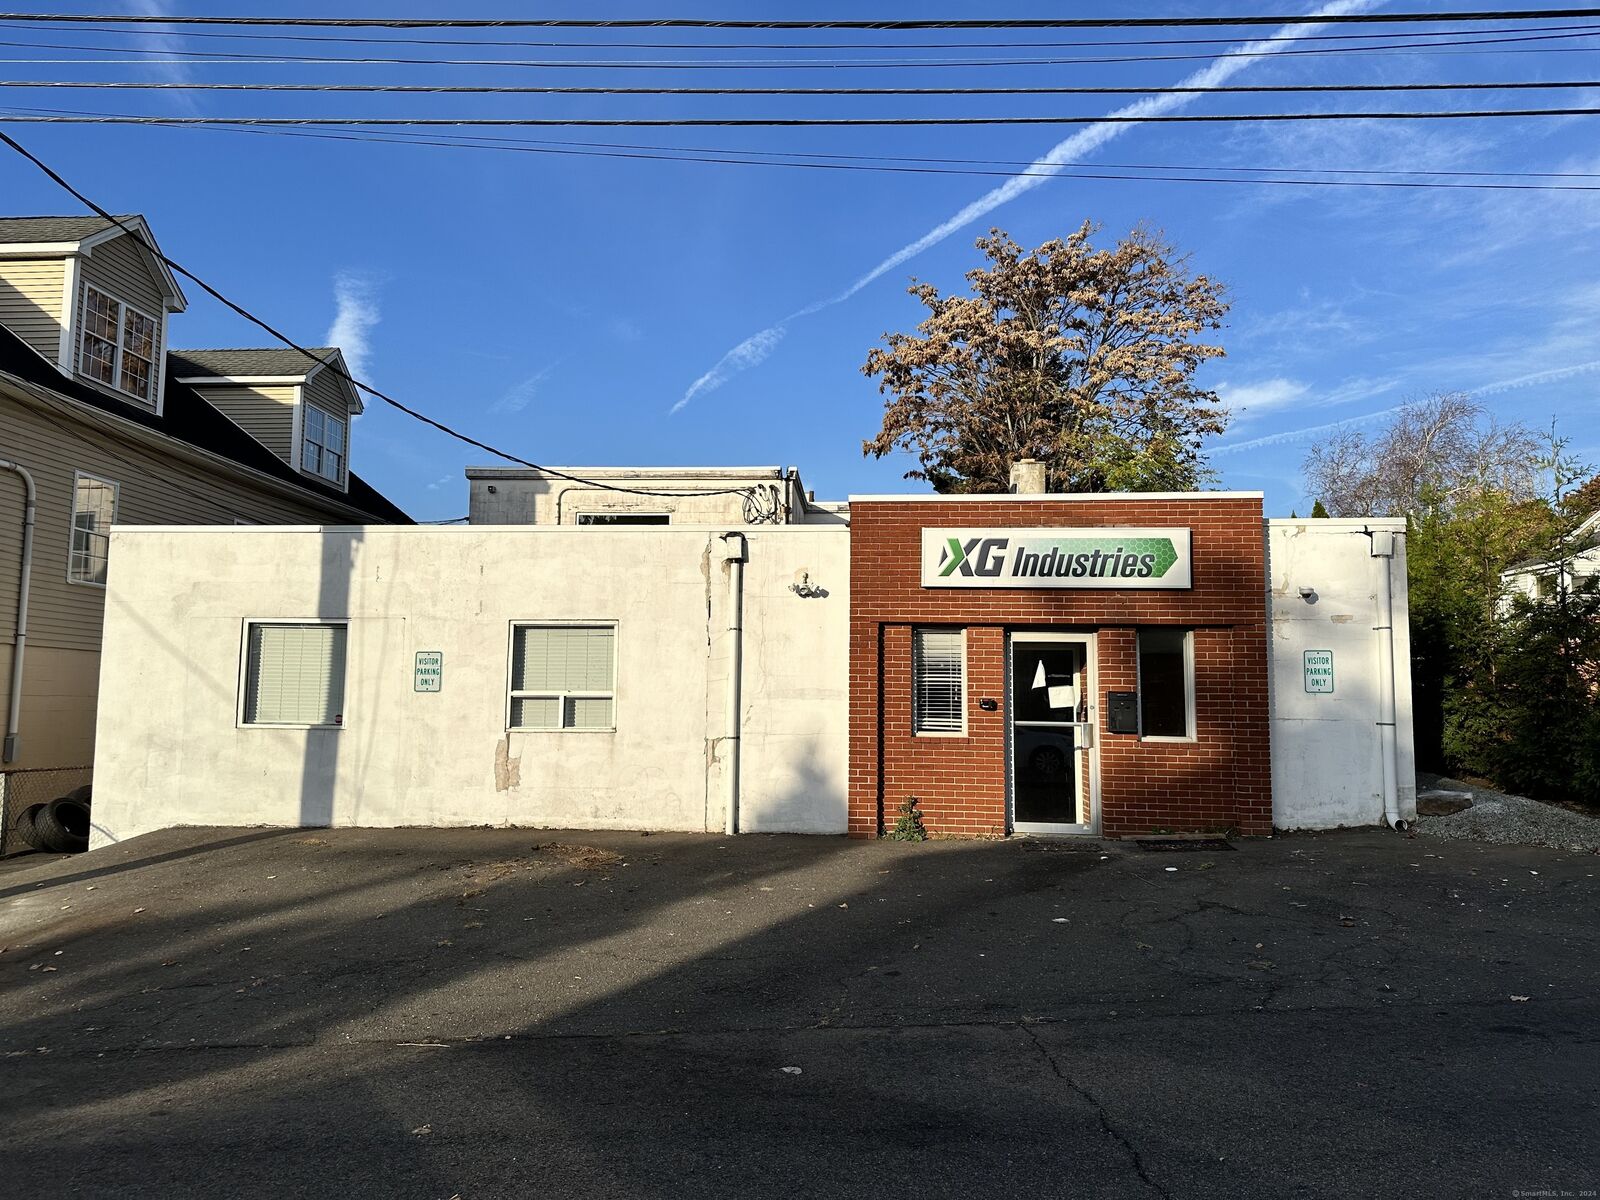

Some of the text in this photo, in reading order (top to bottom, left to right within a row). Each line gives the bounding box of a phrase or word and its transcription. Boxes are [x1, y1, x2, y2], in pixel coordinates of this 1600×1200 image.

[938, 537, 1156, 578] XG Industries
[418, 657, 439, 665] VISITOR
[1307, 656, 1330, 665] VISITOR
[416, 667, 440, 676] PARKING
[1306, 667, 1331, 676] PARKING
[420, 678, 435, 686] ONLY
[1311, 678, 1327, 687] ONLY
